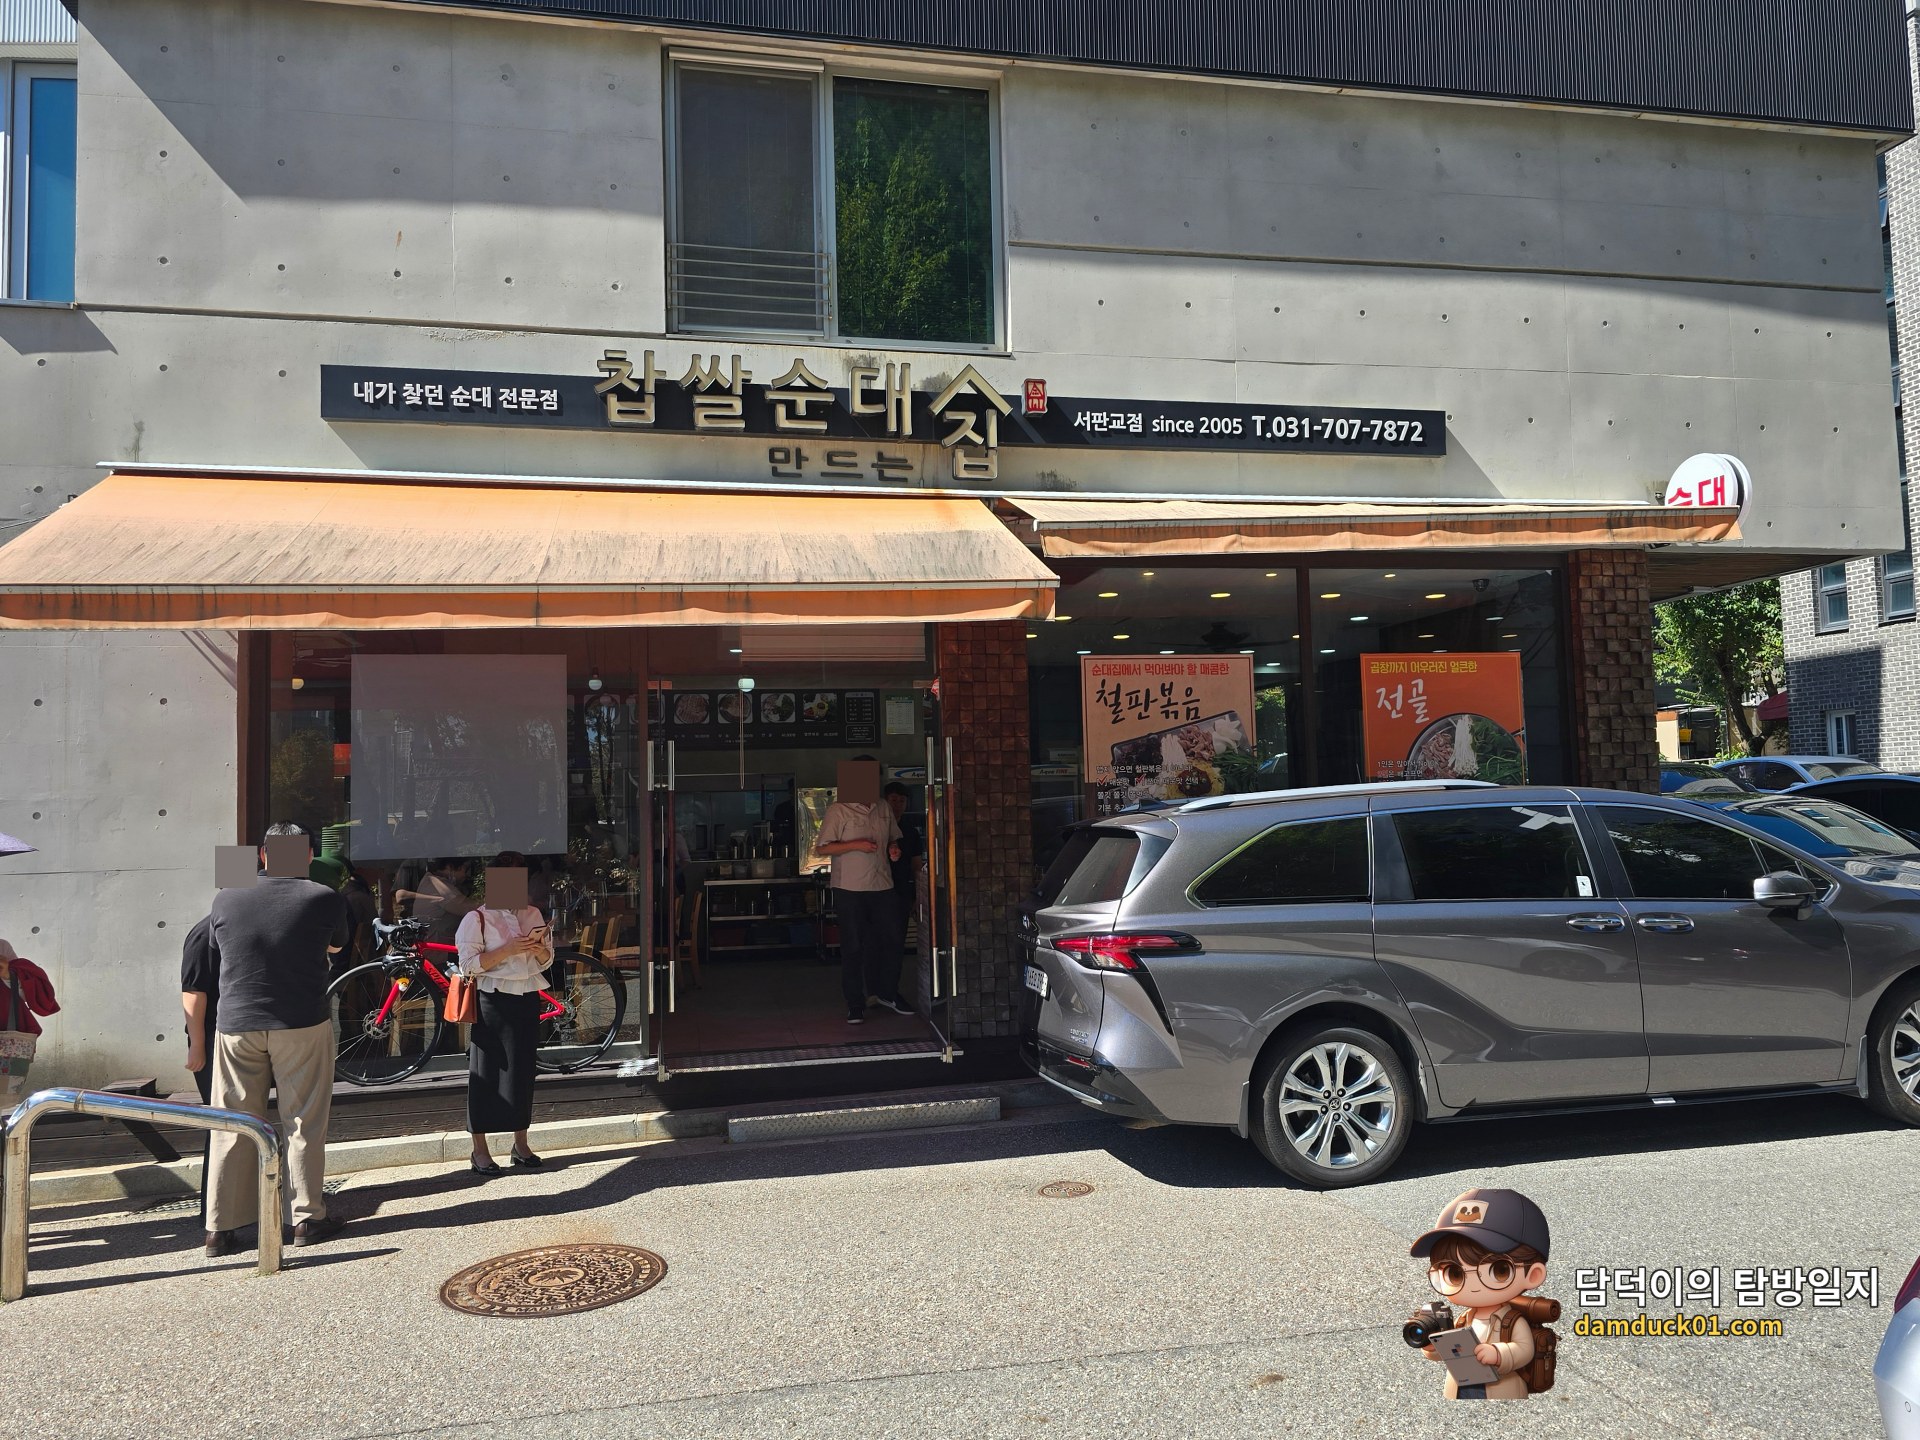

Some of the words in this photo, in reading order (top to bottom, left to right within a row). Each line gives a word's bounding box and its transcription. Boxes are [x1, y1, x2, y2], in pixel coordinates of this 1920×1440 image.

[353, 381, 397, 405] 내가
[402, 383, 444, 406] 찾던
[450, 385, 492, 408] 순대
[498, 387, 558, 410] 전문점
[594, 349, 913, 437] 찹쌀순대
[768, 446, 913, 483] 만드는
[927, 363, 1014, 481] 집
[1073, 410, 1143, 433] 서판교점
[1152, 415, 1195, 433] since
[1199, 416, 1243, 434] 2005
[1251, 415, 1424, 442] T.031-707-7872
[1092, 663, 1141, 677] 순대집에서
[1145, 663, 1184, 676] 먹어봐야
[1187, 663, 1198, 676] 할
[1200, 663, 1230, 676] 매콤한
[1370, 661, 1407, 674] 곱창까지
[1410, 661, 1447, 673] 어우러진
[1449, 660, 1478, 673] 얼큰한
[1095, 679, 1201, 724] 철판볶음
[1376, 678, 1430, 724] 전골
[1097, 803, 1112, 813] 기본
